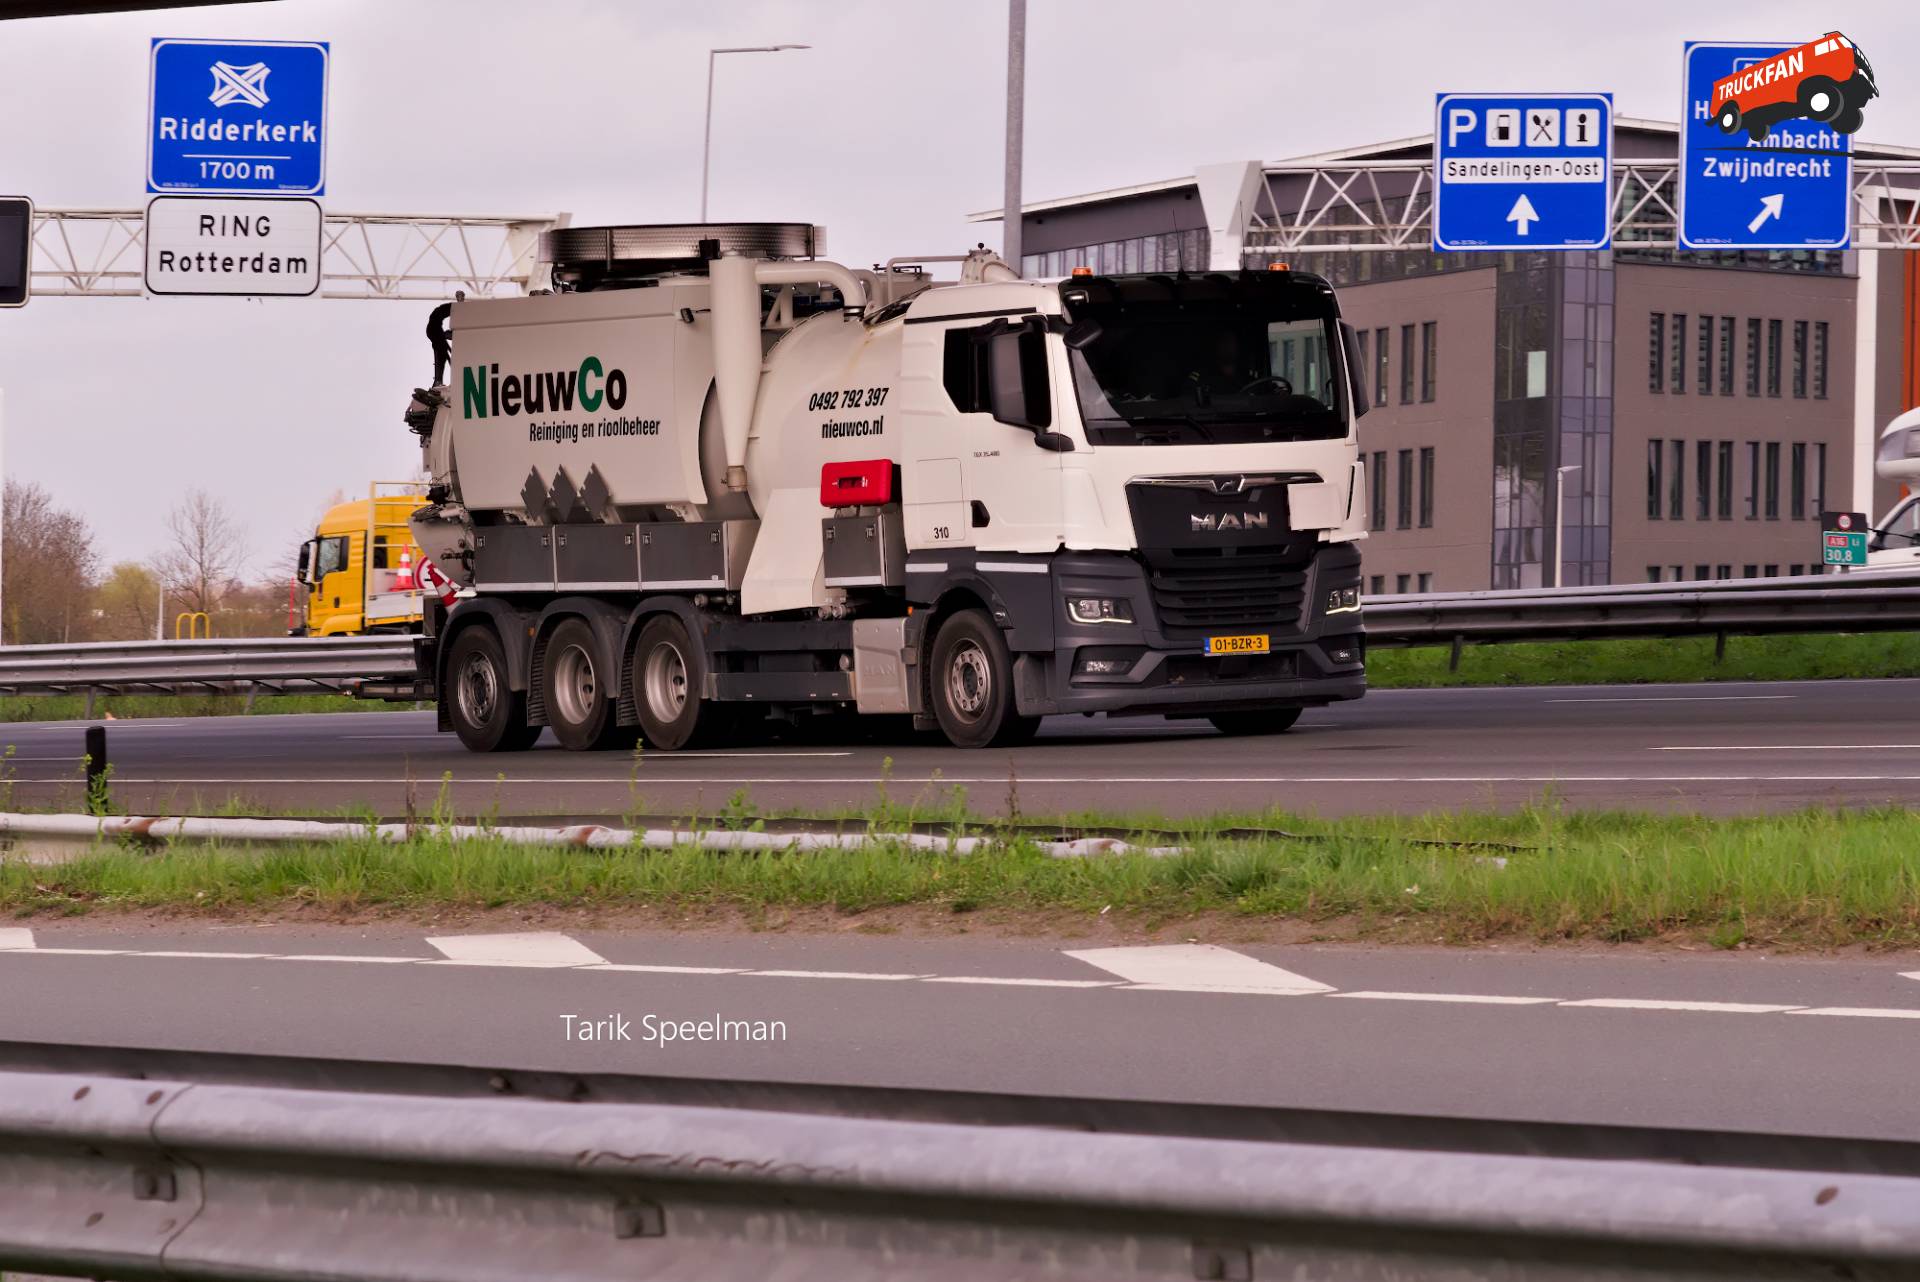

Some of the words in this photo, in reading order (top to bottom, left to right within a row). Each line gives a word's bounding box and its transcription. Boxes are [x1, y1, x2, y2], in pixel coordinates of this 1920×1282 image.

[159, 117, 317, 143] Ridderkerk
[1448, 108, 1477, 147] P
[200, 161, 250, 180] 1700
[254, 164, 275, 180] m
[1448, 161, 1599, 180] Sandelingen-Oost
[1703, 157, 1831, 183] Zwijndrecht
[199, 214, 271, 237] RING
[159, 250, 307, 274] Rotterdam
[463, 356, 627, 419] NieuwCo
[809, 391, 839, 411] 0492
[841, 389, 863, 409] 792
[865, 387, 889, 406] 397
[529, 421, 578, 444] Reiniging
[581, 422, 595, 438] en
[598, 416, 661, 437] rioolbeheer
[822, 416, 884, 438] nieuwco.nl
[934, 527, 950, 539] 310
[1191, 512, 1268, 531] MAN
[1826, 549, 1853, 562] 30.8
[1215, 637, 1263, 651] 01-BZR-3
